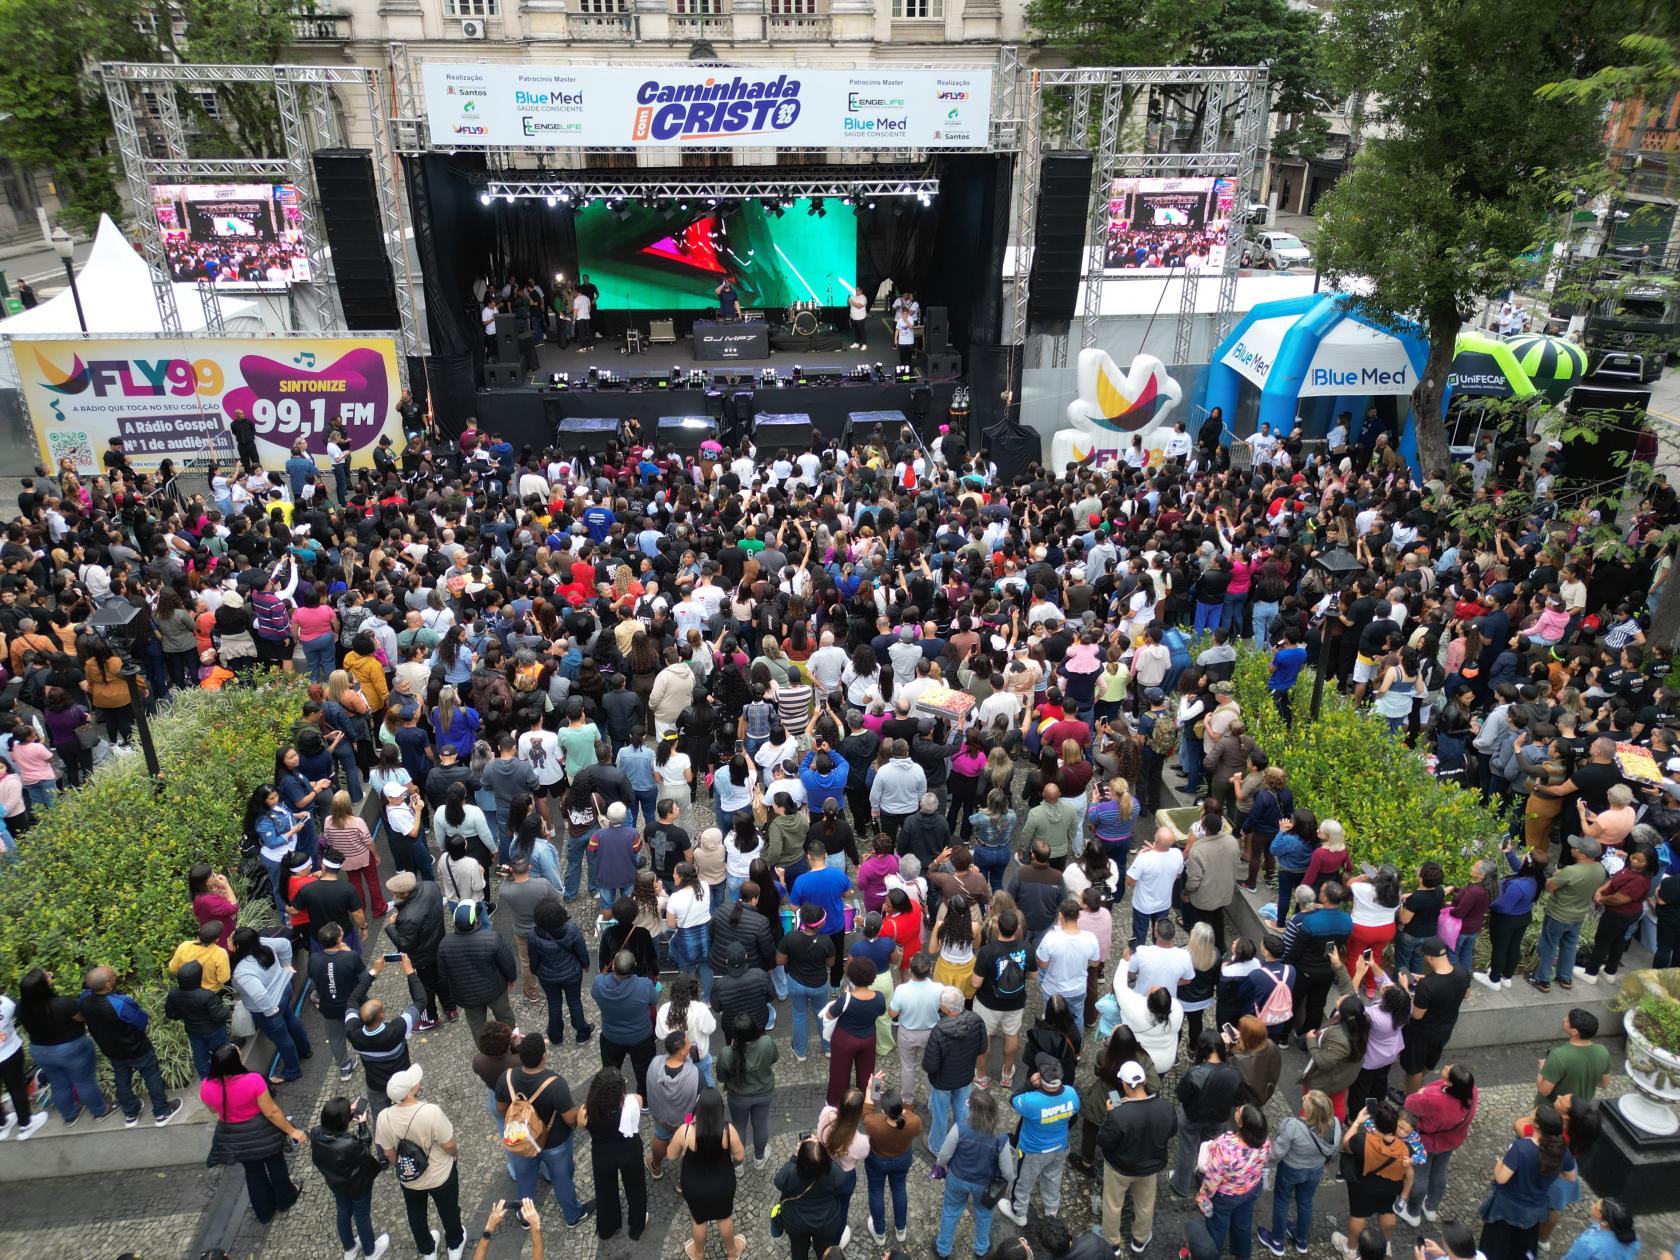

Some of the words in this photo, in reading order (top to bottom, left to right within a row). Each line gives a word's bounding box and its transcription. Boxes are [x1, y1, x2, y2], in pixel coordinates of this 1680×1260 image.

[446, 74, 483, 82] Realização
[936, 79, 971, 87] Realização
[515, 91, 549, 104] Blue
[550, 89, 583, 105] Med
[637, 75, 801, 105] Caminhada
[541, 105, 584, 113] CONSCIENTE
[651, 98, 801, 141] CRISTO
[844, 117, 875, 130] Blue
[876, 115, 908, 130] Med
[944, 133, 971, 141] Santos
[1232, 342, 1252, 367] Blue
[1251, 352, 1272, 377] Med
[87, 358, 225, 397] FLY99
[1314, 368, 1358, 386] Blue
[1361, 364, 1407, 384] Med
[1460, 374, 1506, 385] UniFECAF
[279, 379, 347, 393] SINTONIZE
[80, 403, 106, 412] RÁDIO
[107, 404, 126, 413] QUE
[150, 403, 162, 411] NO
[163, 403, 179, 411] SEU
[180, 402, 220, 411] CORAÇÃO
[125, 422, 136, 434] A
[137, 419, 173, 433] Rádio
[174, 417, 219, 431] Gospel
[252, 398, 327, 439] 99,1
[340, 402, 375, 426] FM
[124, 440, 138, 452] Nº
[140, 439, 147, 450] 1
[149, 438, 166, 449] de
